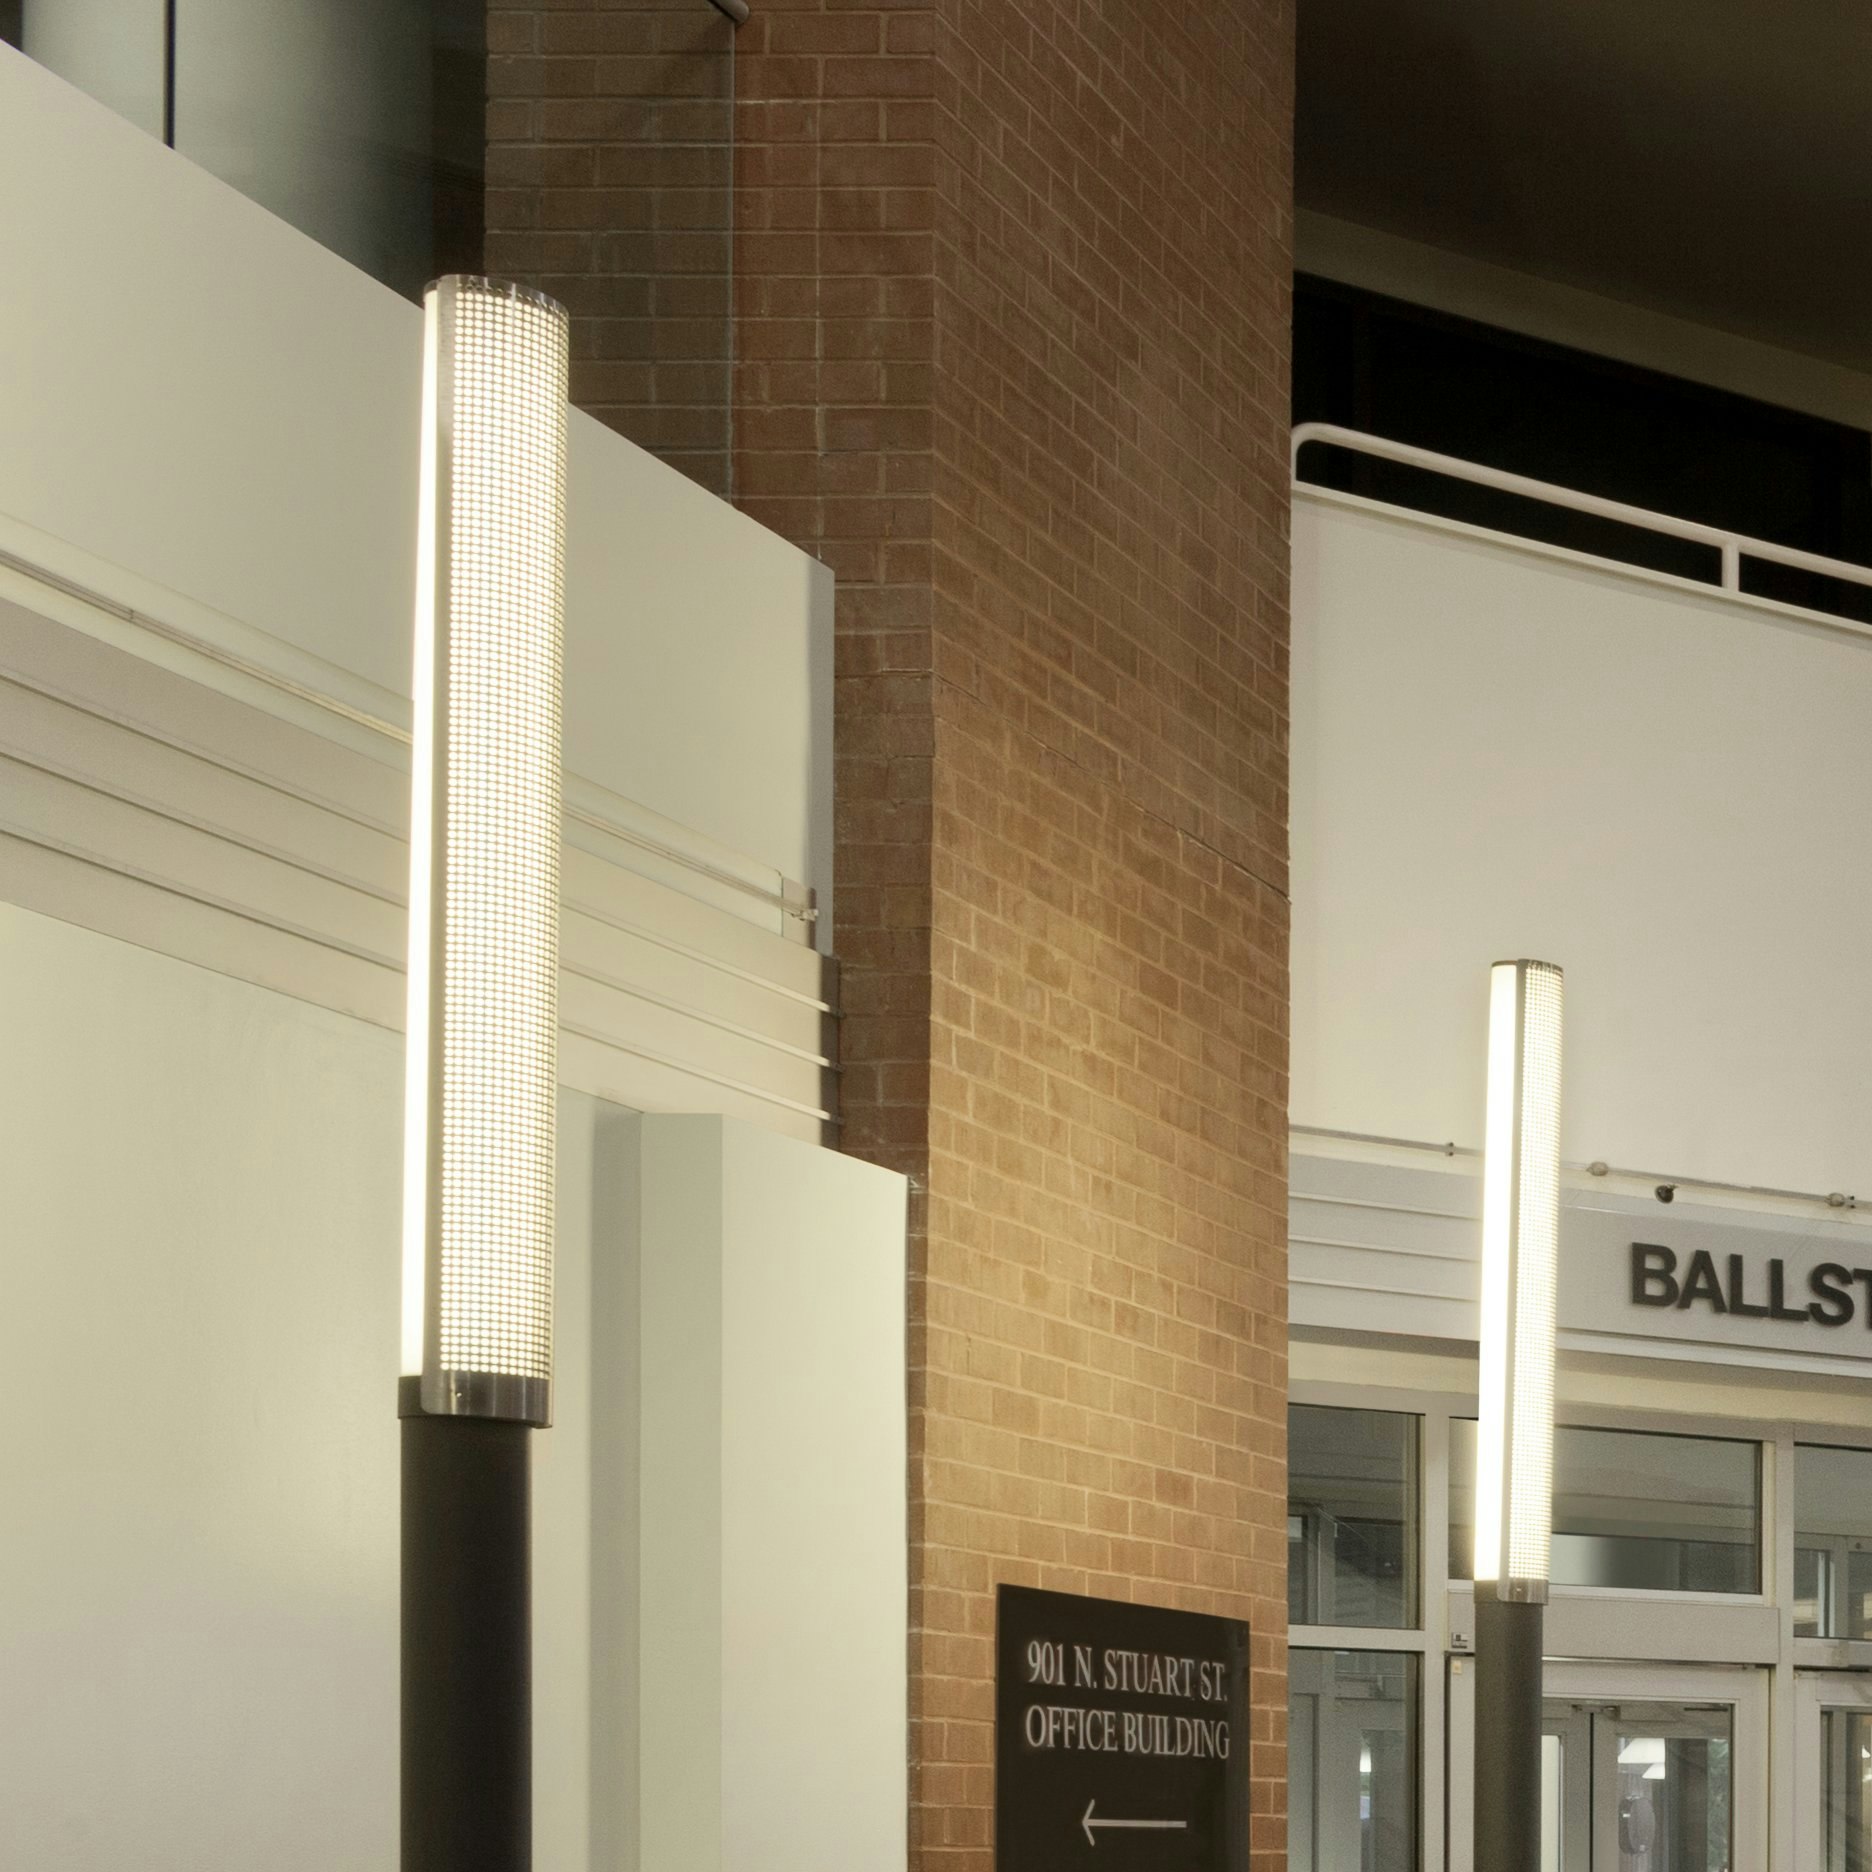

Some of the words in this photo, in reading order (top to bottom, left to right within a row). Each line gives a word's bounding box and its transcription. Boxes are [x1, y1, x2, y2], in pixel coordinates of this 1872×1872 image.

[1027, 1640, 1066, 1686] 901
[1074, 1645, 1098, 1689] N.
[1104, 1649, 1195, 1699] STUART
[1200, 1661, 1228, 1702] ST.
[1025, 1704, 1118, 1752] OFFICE
[1124, 1712, 1230, 1759] BUILDING
